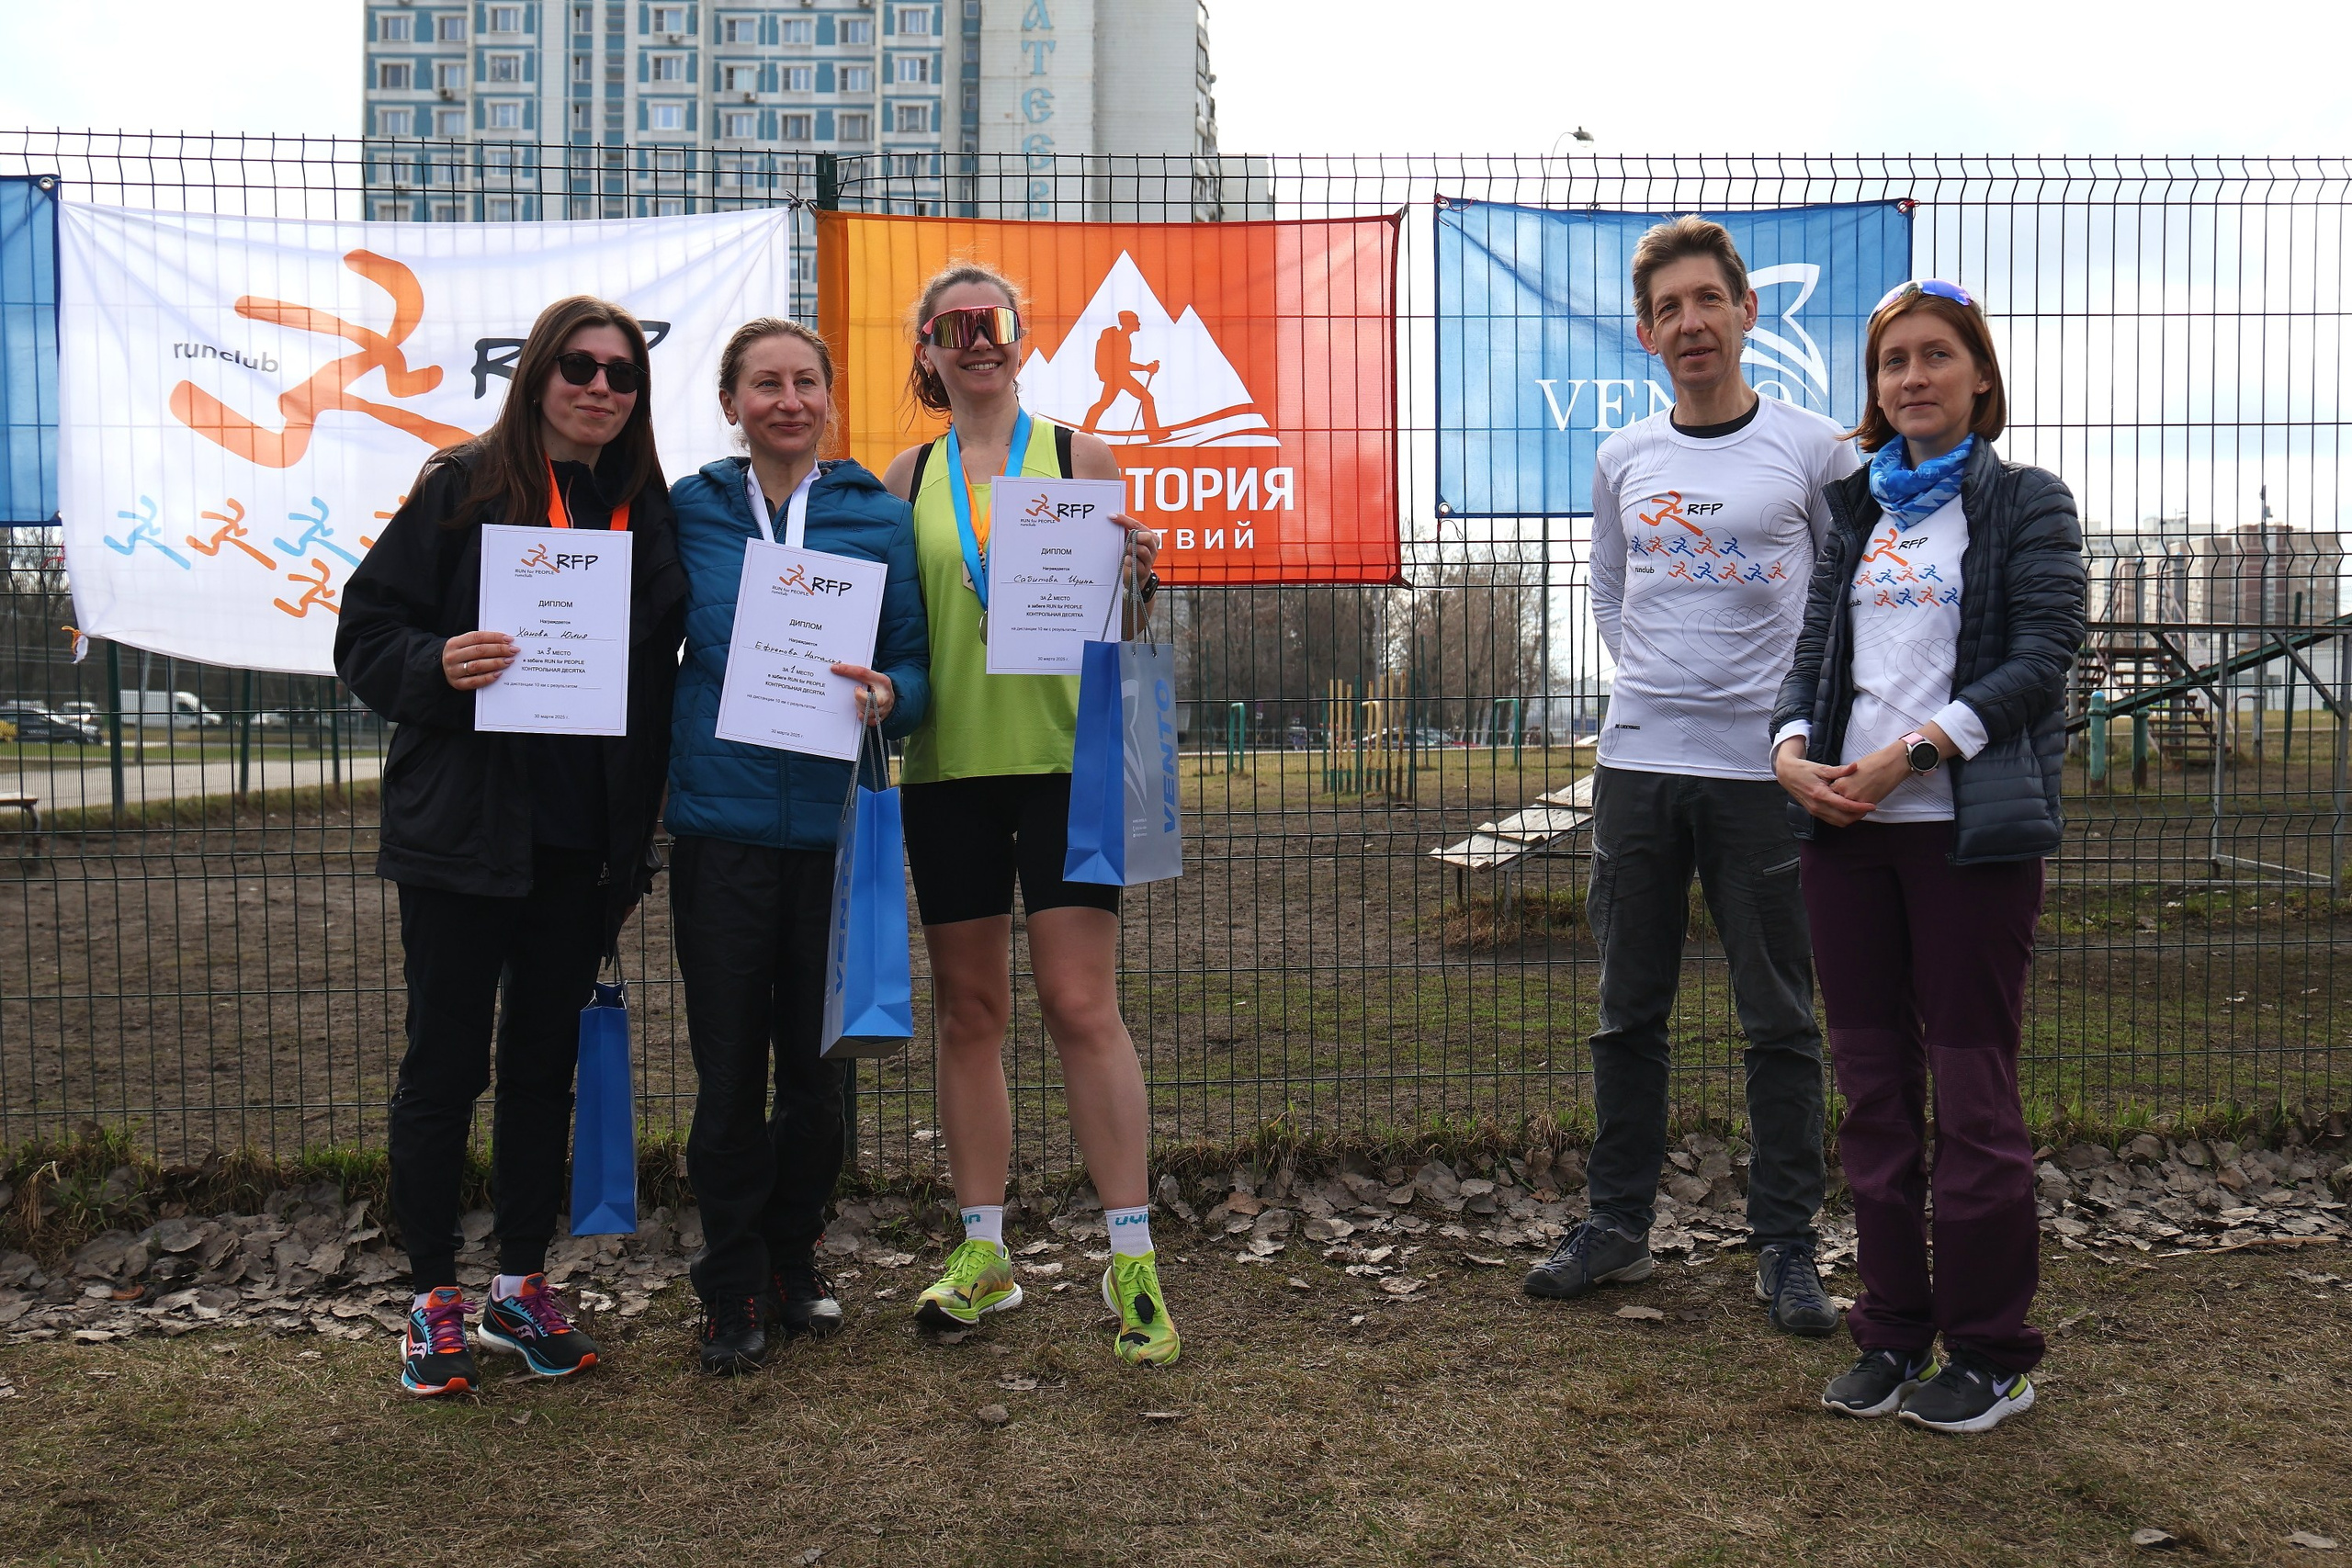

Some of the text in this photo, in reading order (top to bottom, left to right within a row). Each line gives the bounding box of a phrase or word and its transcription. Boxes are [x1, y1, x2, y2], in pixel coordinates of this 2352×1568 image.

[174, 343, 278, 372] runclub
[1119, 467, 1295, 512] ТОРИЯ
[1057, 503, 1095, 519] RFP
[1687, 503, 1724, 515] RFP
[1898, 536, 1928, 550] RFP
[557, 553, 599, 570] RFP
[1635, 566, 1655, 574] runclub
[812, 576, 853, 596] RFP
[1013, 574, 1095, 587] Сабитова Ирина
[791, 589, 808, 597] PEOPLE
[789, 619, 822, 631] ДИПЛОМ
[516, 626, 588, 639] Ханова Юлия
[788, 637, 818, 647] Награждается
[546, 647, 551, 655] 3
[790, 665, 796, 673] 1
[765, 682, 825, 696] КОНТРОЛЬНАЯ ДЕСЯТКА
[806, 680, 825, 688] PEOPLE
[752, 694, 775, 703] дистанции
[790, 702, 816, 710] результатом
[1154, 679, 1177, 833] VENTO
[835, 831, 853, 995] VENTO
